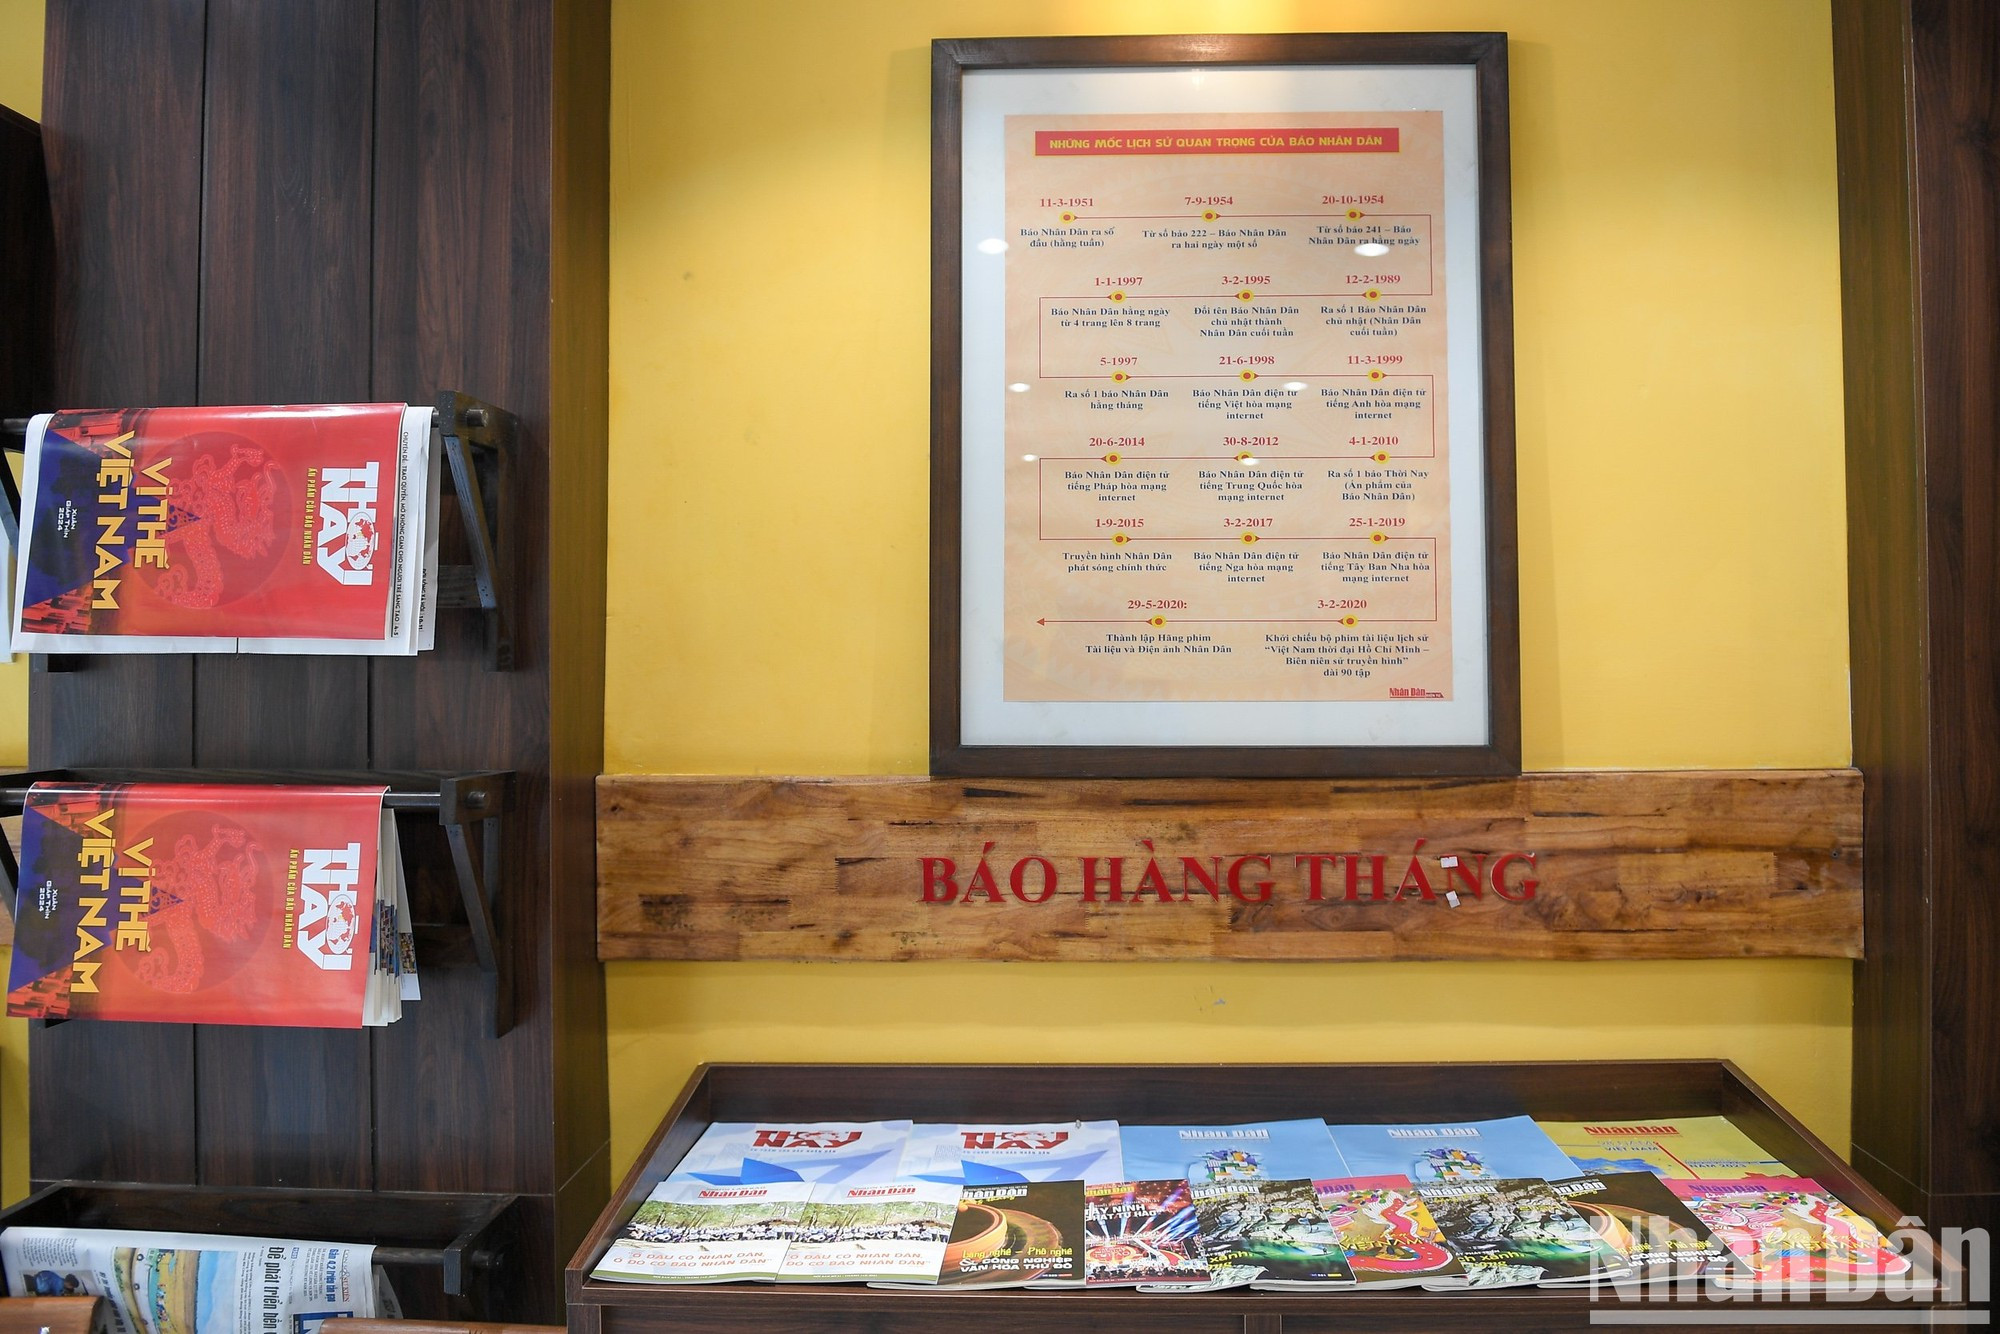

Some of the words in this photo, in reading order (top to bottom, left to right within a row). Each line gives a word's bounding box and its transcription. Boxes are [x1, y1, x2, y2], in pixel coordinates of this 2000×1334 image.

[1049, 138, 1091, 149] NHỮNG
[1094, 136, 1123, 149] MỐC
[1126, 138, 1152, 149] LỊCH
[1155, 136, 1173, 148] SỬ
[1175, 137, 1212, 148] QUAN
[1215, 137, 1256, 147] TRỌNG
[1259, 135, 1285, 147] CỦA
[1289, 137, 1315, 146] BÁO
[1318, 136, 1353, 146] NHÂN
[1356, 136, 1382, 146] DÂN
[1040, 197, 1093, 208] 11-3-1951
[1184, 196, 1234, 206] 7-9-1954
[1322, 194, 1385, 205] 20-10-1954
[1020, 228, 1039, 237] Báo
[1041, 228, 1067, 236] Nhân
[1069, 227, 1089, 236] Dân
[1103, 227, 1115, 236] số
[1029, 238, 1048, 248] đầu
[1050, 238, 1077, 249] (hằng
[1079, 237, 1105, 247] tuần)
[1095, 276, 1143, 287] 1-1-1997
[1221, 275, 1271, 285] 3-2-1995
[1346, 274, 1401, 284] 12-2-1989
[1100, 356, 1138, 366] 5-1997
[1219, 355, 1275, 365] 21-6-1998
[1348, 355, 1403, 365] 11-3-1999
[1089, 436, 1145, 447] 20-6-2014
[1223, 436, 1279, 446] 30-8-2012
[1348, 436, 1399, 446] 4-1-2010
[96, 430, 136, 510] VIỆT
[307, 468, 317, 477] ẤN
[1327, 470, 1341, 478] Ra
[1343, 469, 1354, 478] số
[1357, 470, 1361, 478] 1
[1364, 469, 1382, 478] báo
[1386, 469, 1408, 478] Thời
[1410, 469, 1428, 479] Nay
[135, 457, 172, 496] VỊ
[306, 480, 317, 498] PHẨM
[1344, 479, 1363, 490] (Ấn
[1365, 481, 1393, 491] phẩm
[1342, 492, 1361, 501] Báo
[1363, 492, 1389, 501] Nhân
[1392, 492, 1415, 501] Dân)
[64, 500, 72, 519] GIÁP
[305, 500, 316, 513] CỦA
[57, 506, 65, 531] 2024
[70, 507, 78, 530] XUÂN
[304, 515, 315, 528] BÁO
[1096, 518, 1145, 528] 1-9-2015
[1223, 517, 1273, 528] 3-2-2017
[1349, 517, 1406, 527] 25-1-2019
[63, 519, 71, 539] THÌN
[316, 467, 349, 586] NAY
[133, 500, 172, 569] THẾ
[303, 531, 313, 549] NHÂN
[303, 551, 313, 565] DÂN
[1064, 550, 1097, 562] Truyền
[1100, 552, 1121, 560] hình
[1124, 552, 1150, 560] Nhân
[1153, 551, 1172, 560] Dân
[92, 516, 126, 610] NAM
[1068, 563, 1089, 573] phát
[1091, 563, 1114, 573] sóng
[1116, 563, 1143, 572] chính
[1145, 563, 1167, 571] thức
[1127, 599, 1187, 610] 29-5-2020:
[1317, 599, 1368, 609] 3-2-2020
[1105, 633, 1137, 642] Thành
[1140, 633, 1155, 644] lập
[1158, 633, 1184, 643] Hãng
[1186, 633, 1211, 644] phim
[1087, 645, 1102, 654] Tài
[1104, 645, 1121, 655] liệu
[1124, 645, 1135, 653] và
[1138, 645, 1160, 655] Điện
[1162, 645, 1181, 653] ảnh
[1183, 645, 1209, 653] Nhân
[1212, 645, 1232, 653] Dân
[76, 808, 115, 891] VIỆT
[290, 849, 300, 859] ẤN
[117, 837, 154, 877] VỊ
[288, 861, 299, 879] PHẨM
[917, 840, 1058, 903] BÁO
[1080, 839, 1275, 903] HÀNG
[1295, 838, 1539, 903] THÁNG
[287, 882, 297, 895] CỦA
[51, 889, 59, 911] XUÂN
[285, 898, 296, 910] BÁO
[297, 848, 331, 970] NAY
[115, 879, 152, 953] THẾ
[284, 913, 295, 932] NHÂN
[70, 897, 106, 994] NAM
[283, 935, 293, 948] DÂN
[1583, 1125, 1637, 1134] Nhân
[1639, 1124, 1678, 1134] Dân
[752, 1138, 860, 1148] NAY
[963, 1140, 1063, 1150] NAY
[698, 1189, 737, 1198] Nhân
[739, 1188, 768, 1197] Dân
[848, 1188, 885, 1197] Nhân
[887, 1187, 916, 1196] Dân
[268, 1247, 286, 1260] Để
[959, 1257, 978, 1267] &
[264, 1262, 281, 1283] phát
[263, 1286, 282, 1310] triển
[262, 1312, 282, 1328] bền
